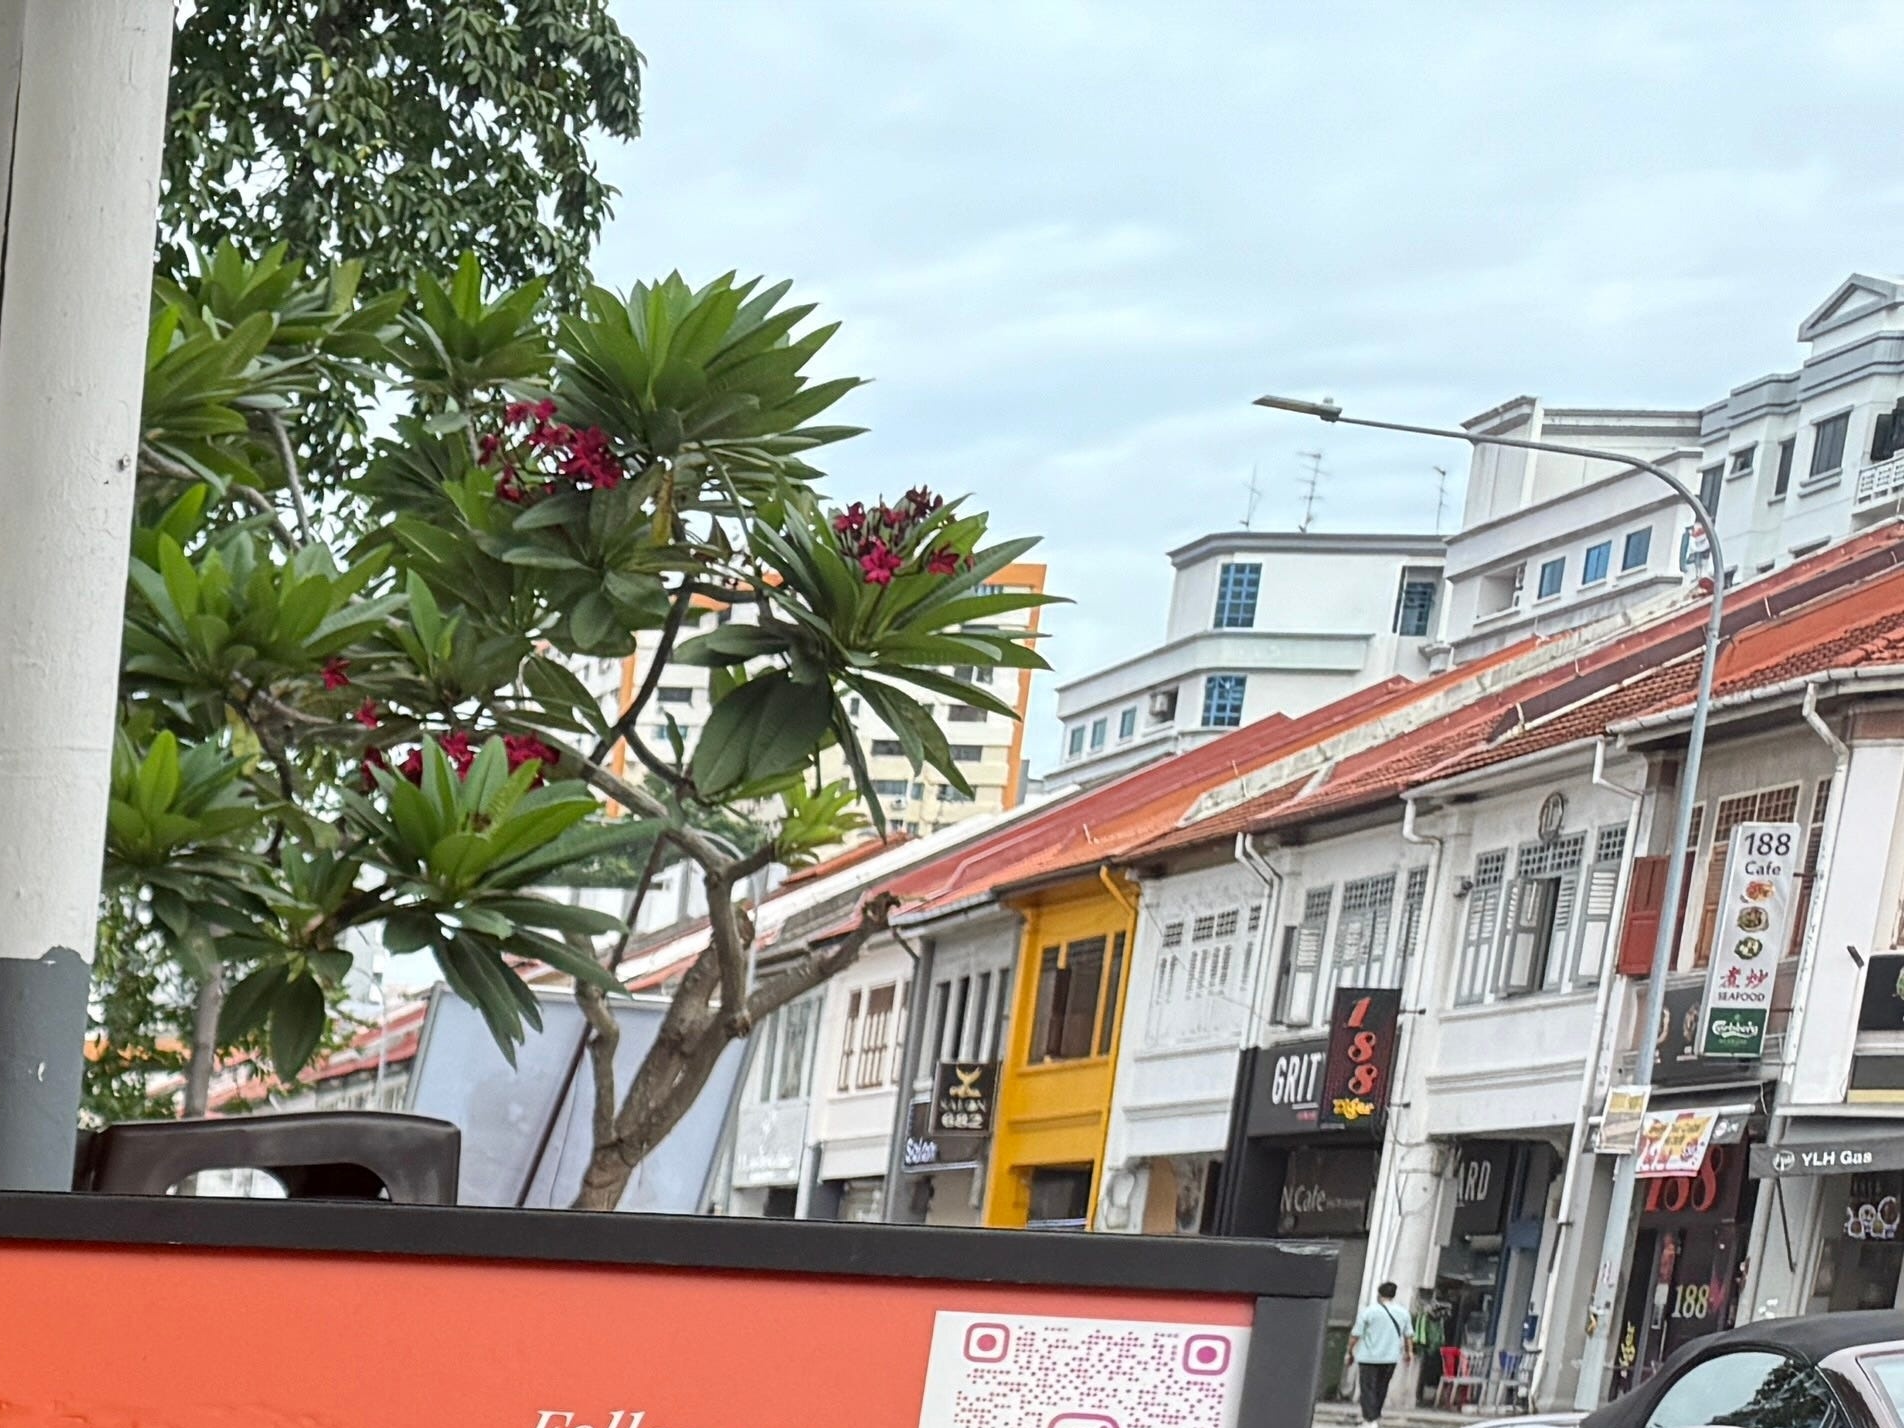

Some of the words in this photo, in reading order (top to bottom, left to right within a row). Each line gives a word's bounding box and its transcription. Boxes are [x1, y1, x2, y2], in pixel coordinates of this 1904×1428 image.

[1744, 832, 1792, 857] 188
[1744, 860, 1782, 877] Cafe
[1717, 991, 1765, 1002] SEAFOOD
[1272, 1051, 1326, 1105] GRIT
[1802, 1151, 1835, 1167] YLH
[1840, 1150, 1873, 1165] Gas
[1671, 1284, 1710, 1319] 188
